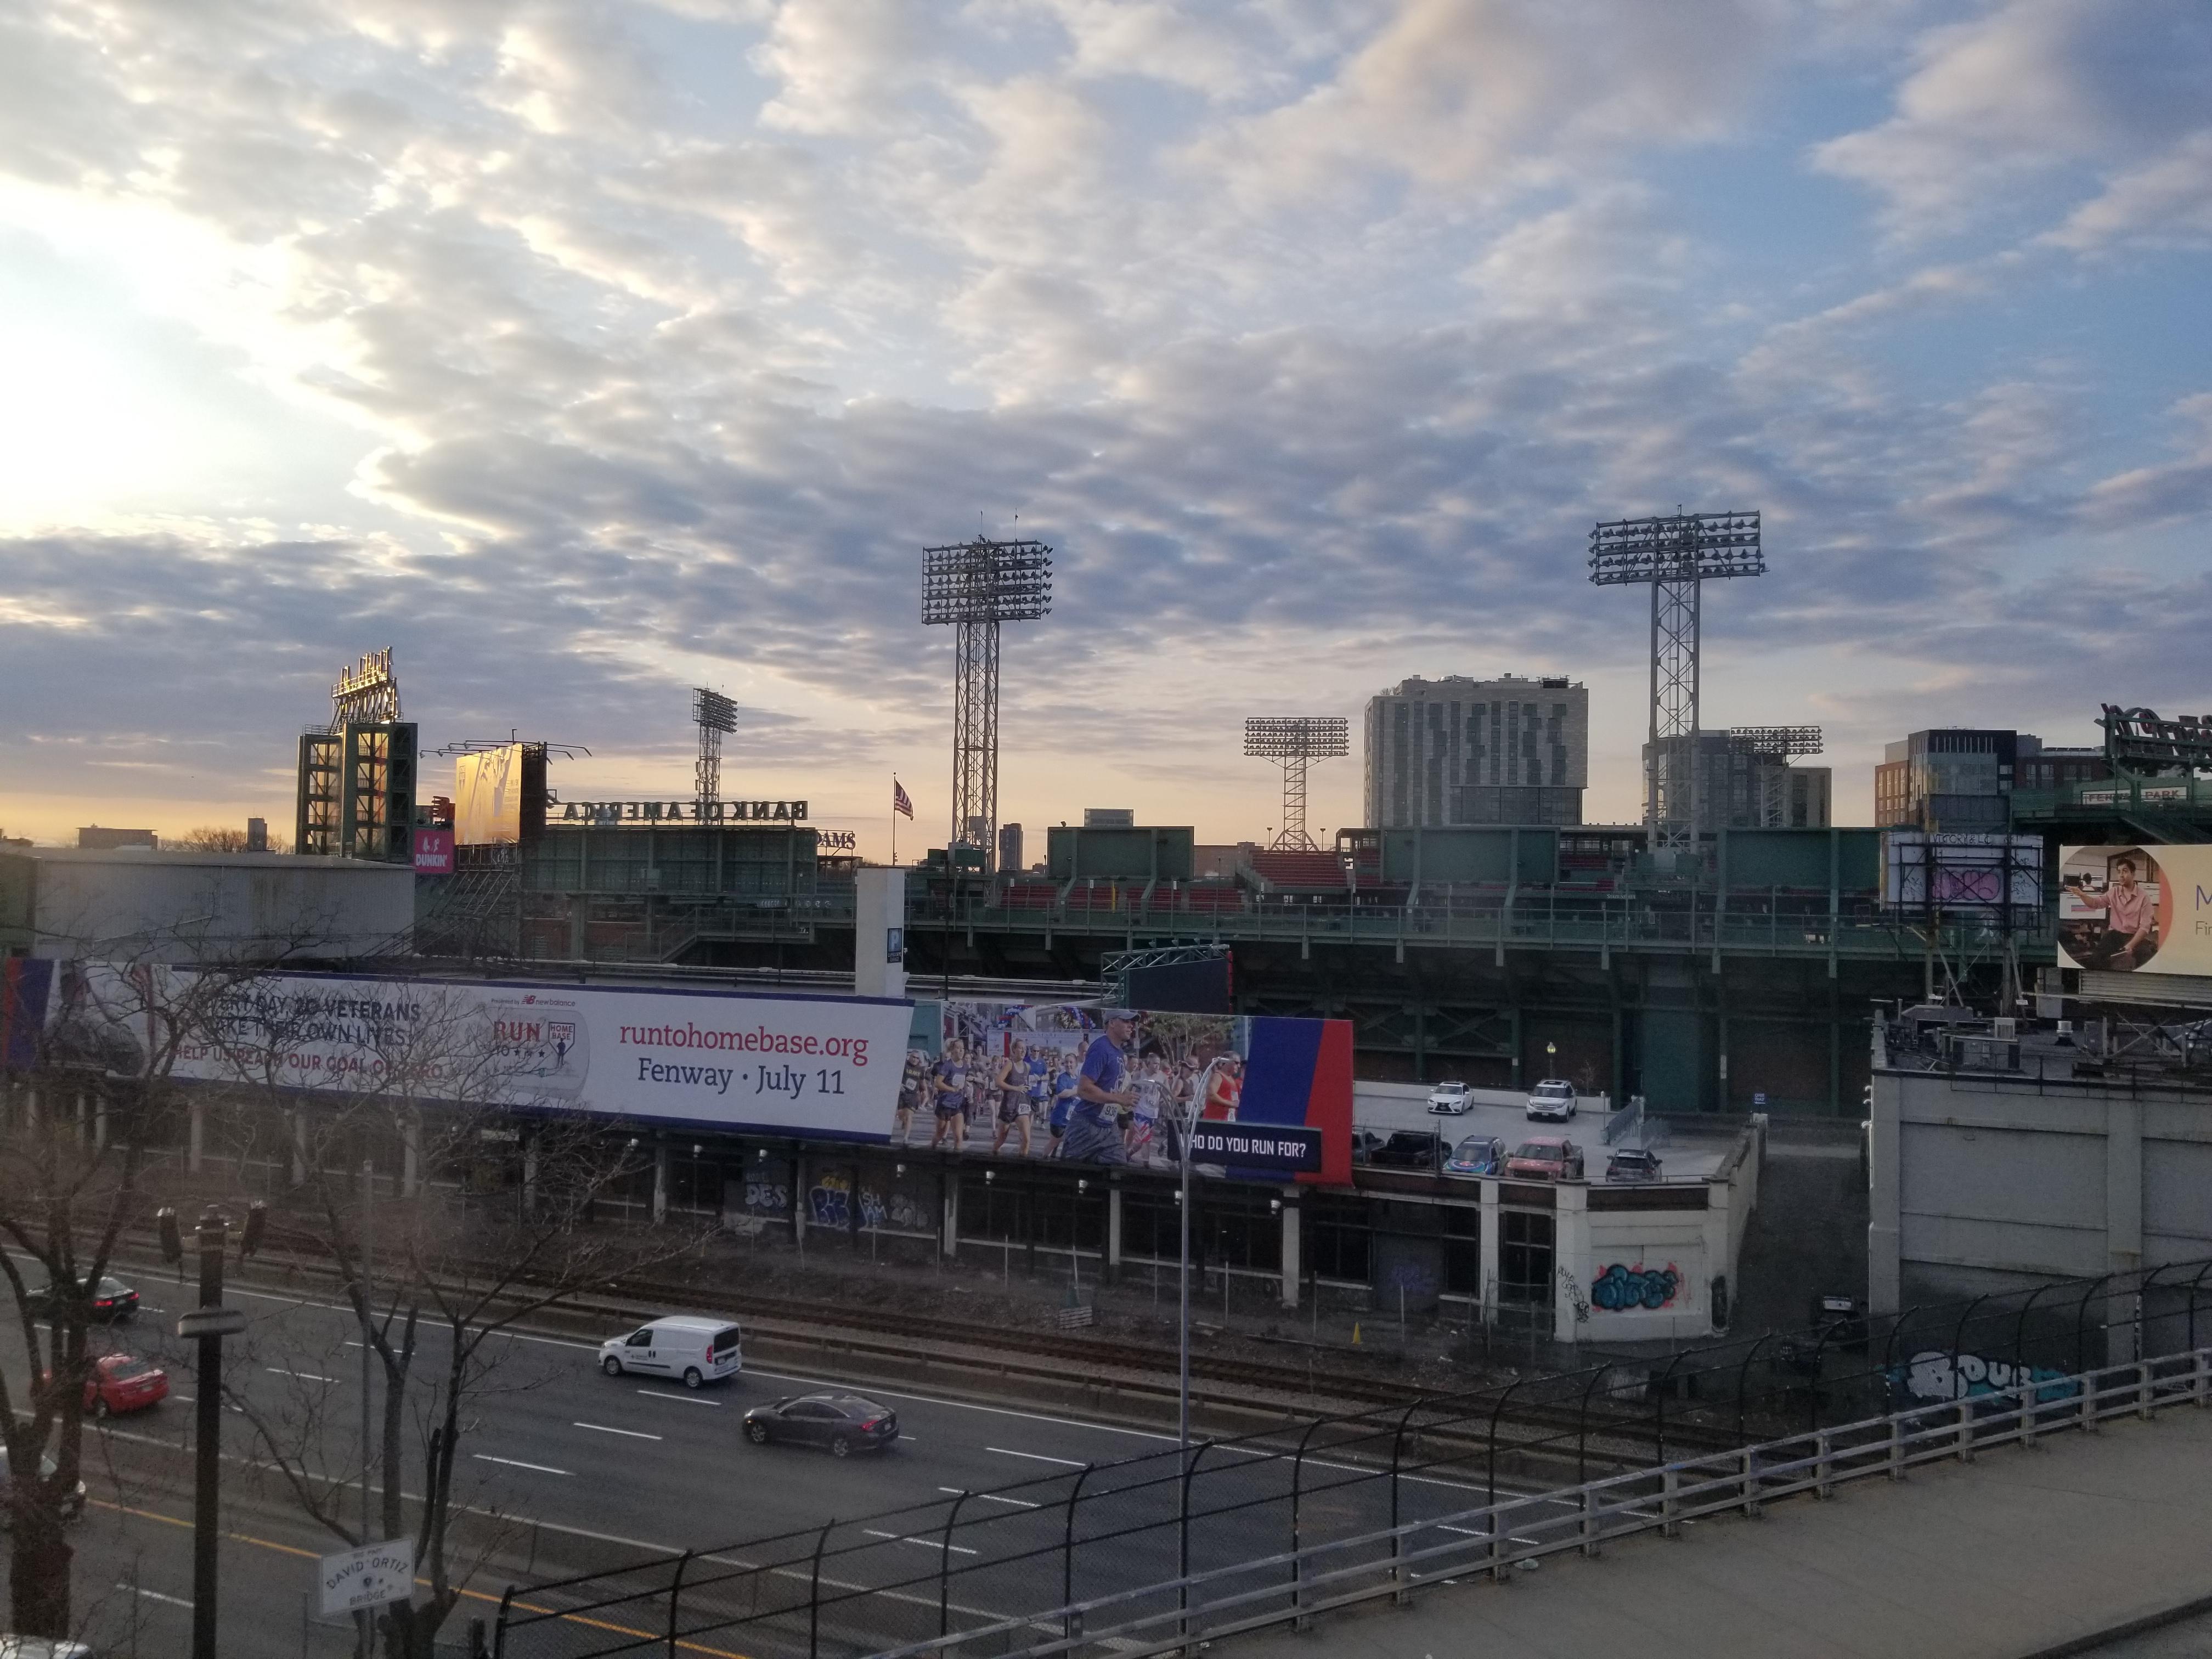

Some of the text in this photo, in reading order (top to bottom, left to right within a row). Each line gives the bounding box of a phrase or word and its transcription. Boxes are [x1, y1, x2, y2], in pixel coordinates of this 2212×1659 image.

[2145, 790, 2179, 799] PARK
[415, 854, 448, 867] DUNKIN'
[330, 1000, 420, 1022] VETERANS
[550, 998, 575, 1007] balance
[493, 1020, 541, 1042] RUN
[620, 1022, 869, 1066] runtohomebase.org
[288, 1053, 320, 1070] OUR
[326, 1055, 365, 1074] GOAL
[638, 1057, 845, 1099] Fenway July 11
[1208, 1136, 1223, 1150] DO
[1226, 1137, 1249, 1153] YOU
[1252, 1139, 1274, 1155] RUN
[1278, 1141, 1306, 1158] FOR?
[326, 1557, 408, 1589] DAVID ORTIZ
[349, 1590, 387, 1606] BRIDGE
